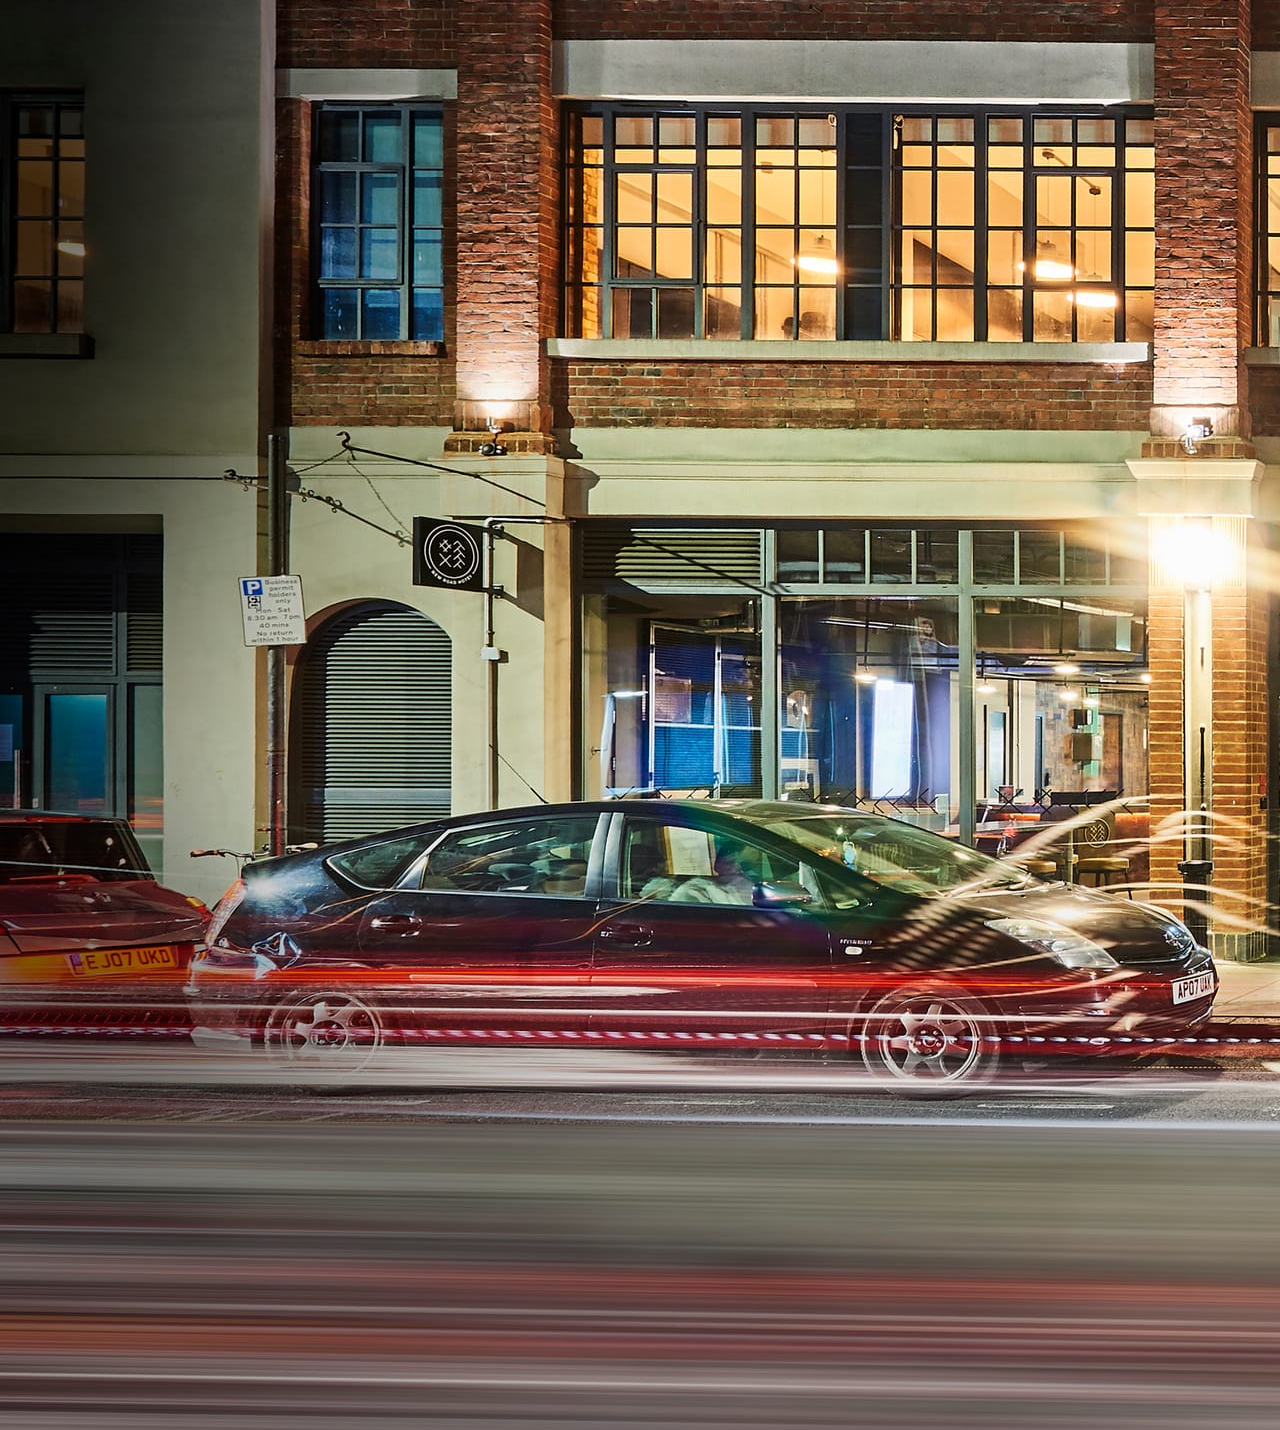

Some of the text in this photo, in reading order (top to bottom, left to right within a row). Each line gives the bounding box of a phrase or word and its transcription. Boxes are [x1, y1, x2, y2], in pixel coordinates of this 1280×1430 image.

[85, 949, 171, 969] EJ07 UKD
[1178, 979, 1199, 999] AP07
